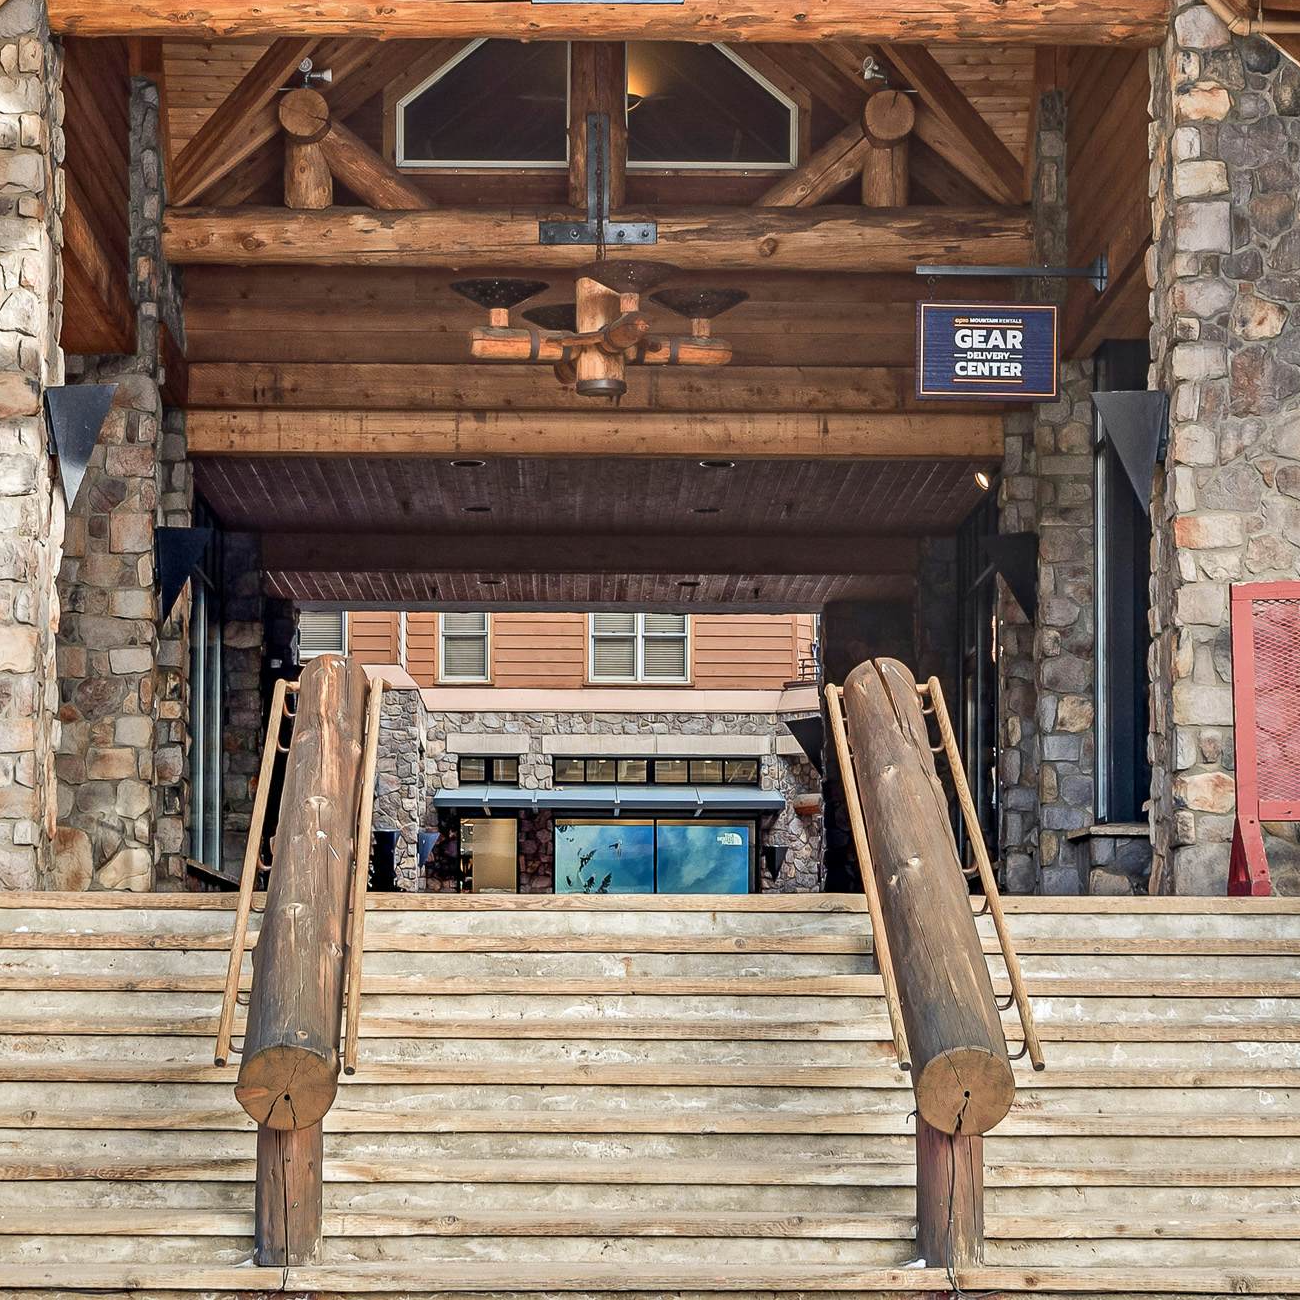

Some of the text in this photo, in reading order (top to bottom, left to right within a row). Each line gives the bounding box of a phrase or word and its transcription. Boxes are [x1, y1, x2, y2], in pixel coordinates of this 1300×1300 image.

[954, 328, 1023, 349] GEAR
[966, 351, 1010, 360] DELIVERY
[954, 361, 1022, 377] CENTER
